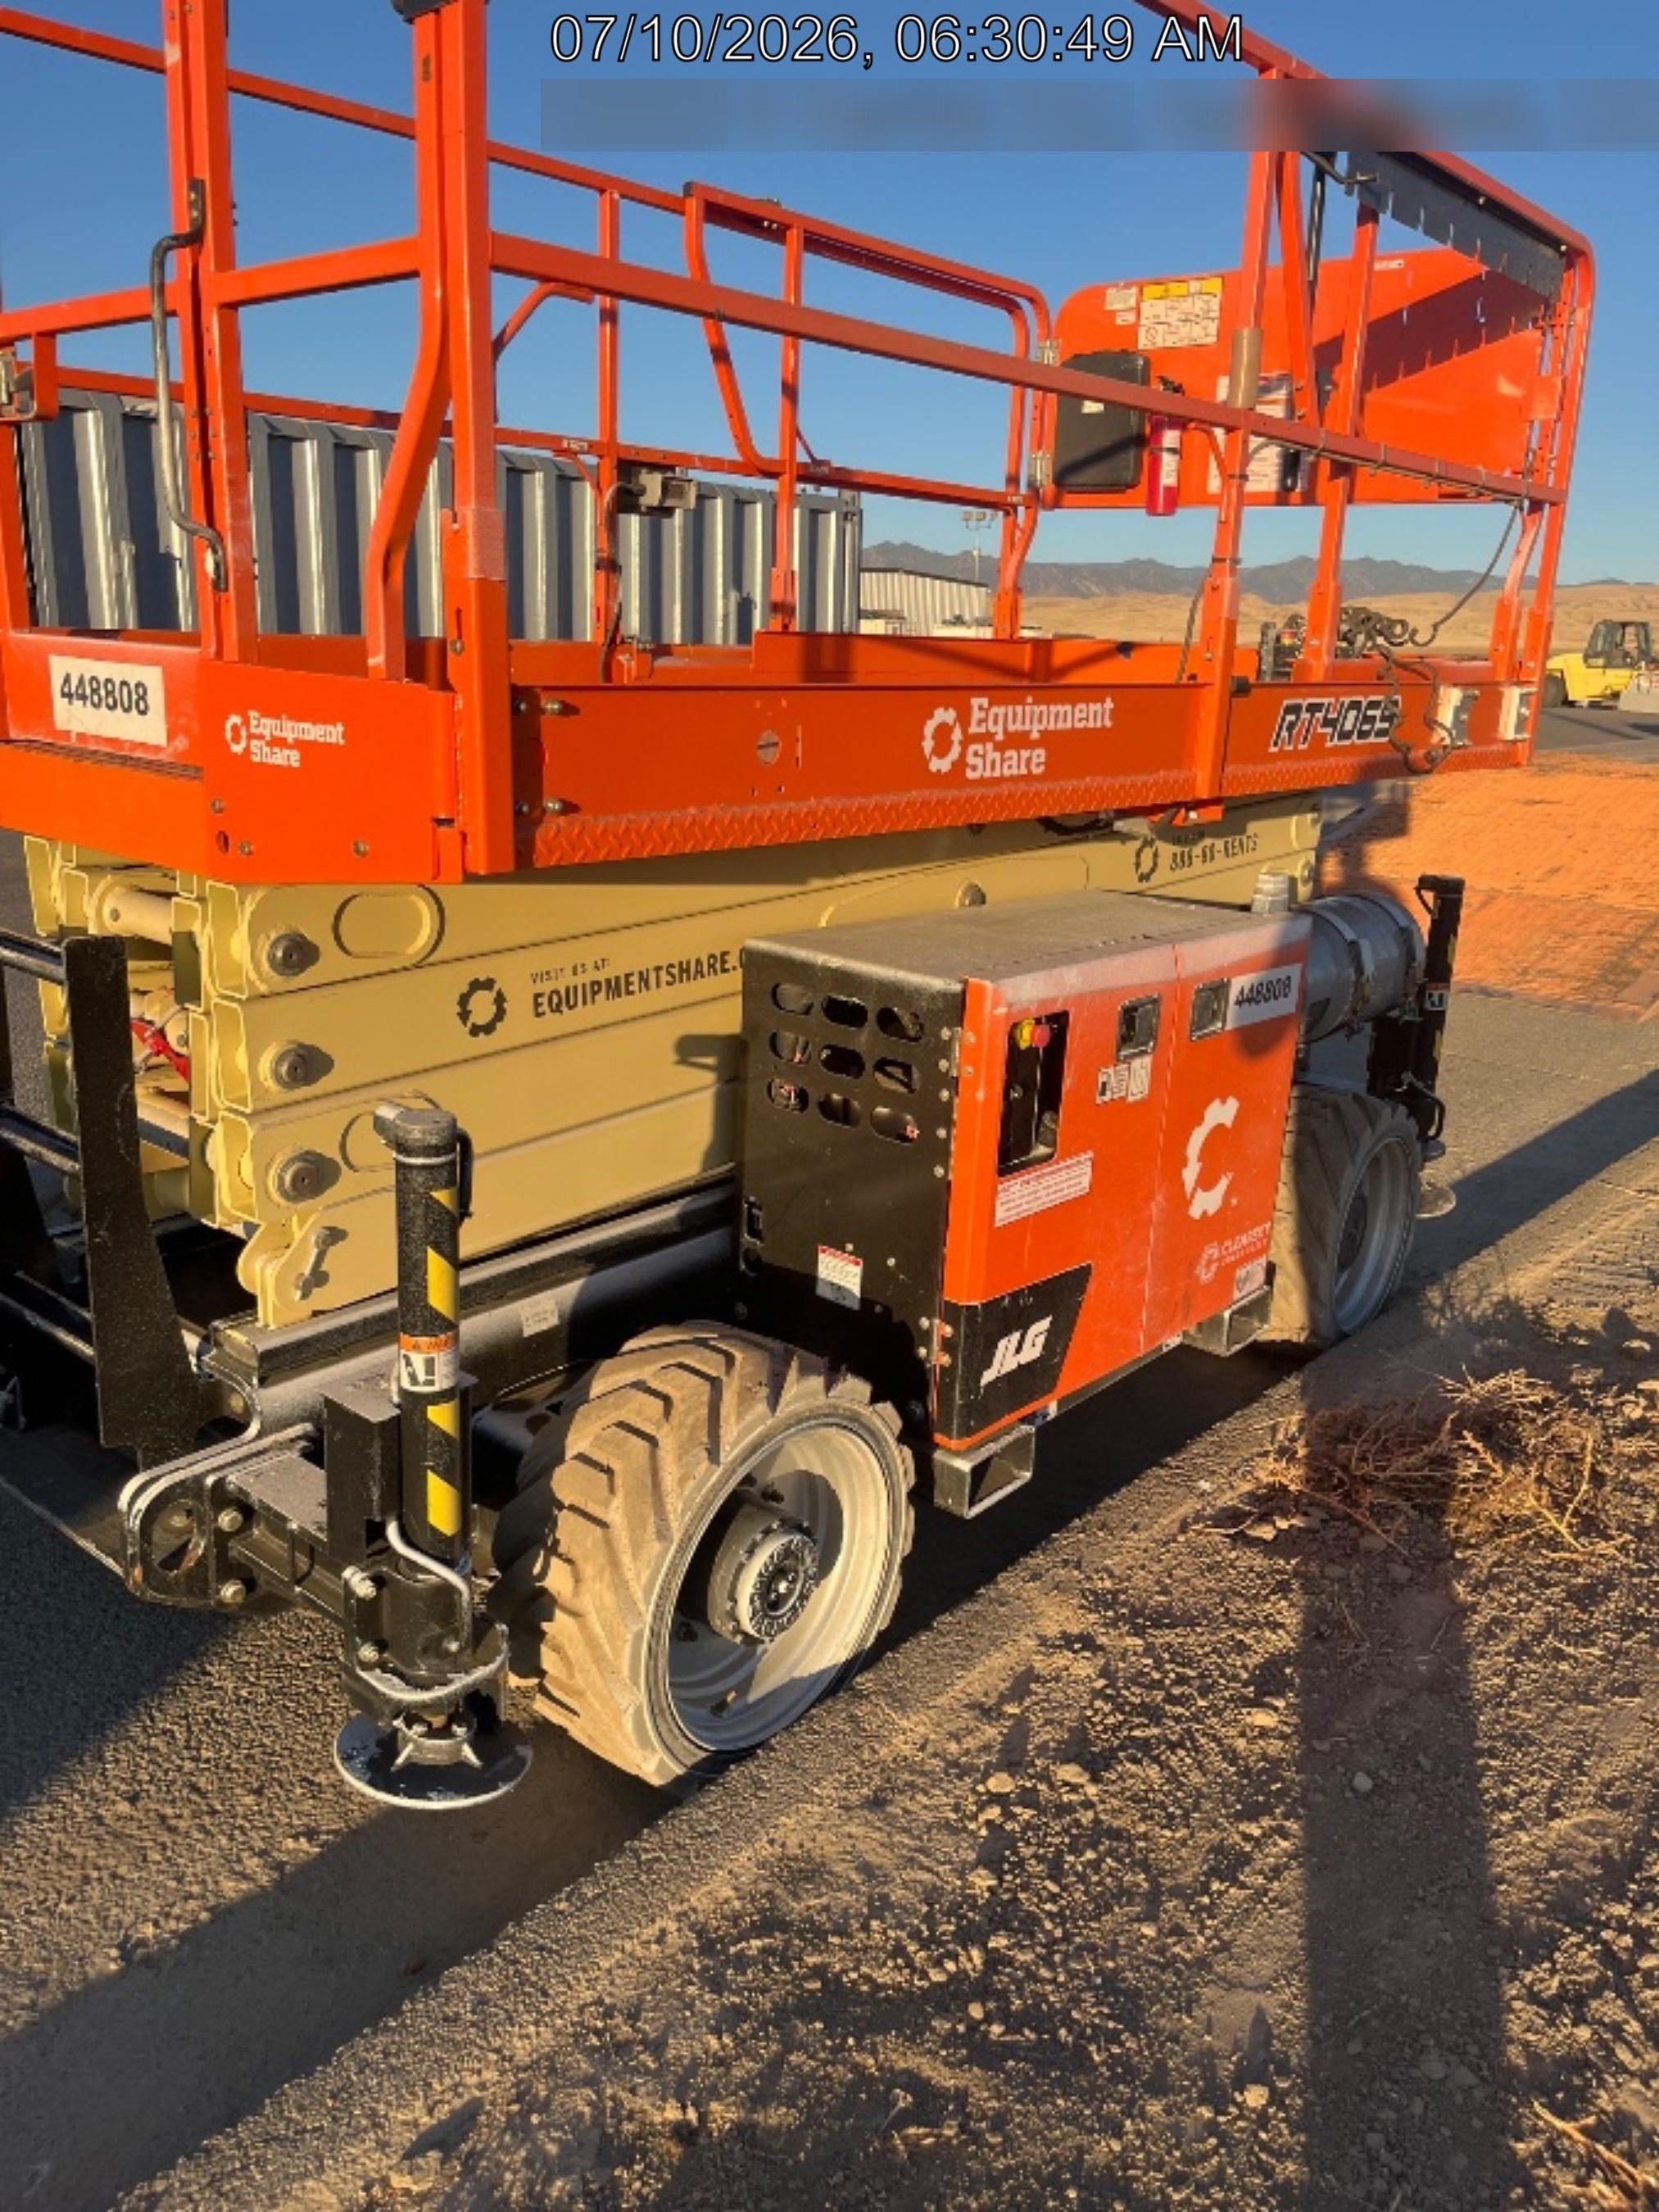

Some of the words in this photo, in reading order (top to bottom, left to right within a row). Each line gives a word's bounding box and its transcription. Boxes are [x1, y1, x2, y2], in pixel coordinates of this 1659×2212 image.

[60, 673, 149, 716] 448808
[248, 709, 345, 746] Equipment
[968, 696, 1115, 741] Equipment
[249, 740, 301, 768] Share
[965, 741, 1047, 780] Share
[530, 968, 563, 986] VISIT
[1233, 975, 1292, 1009] 448808
[980, 1313, 1053, 1388] JLG
